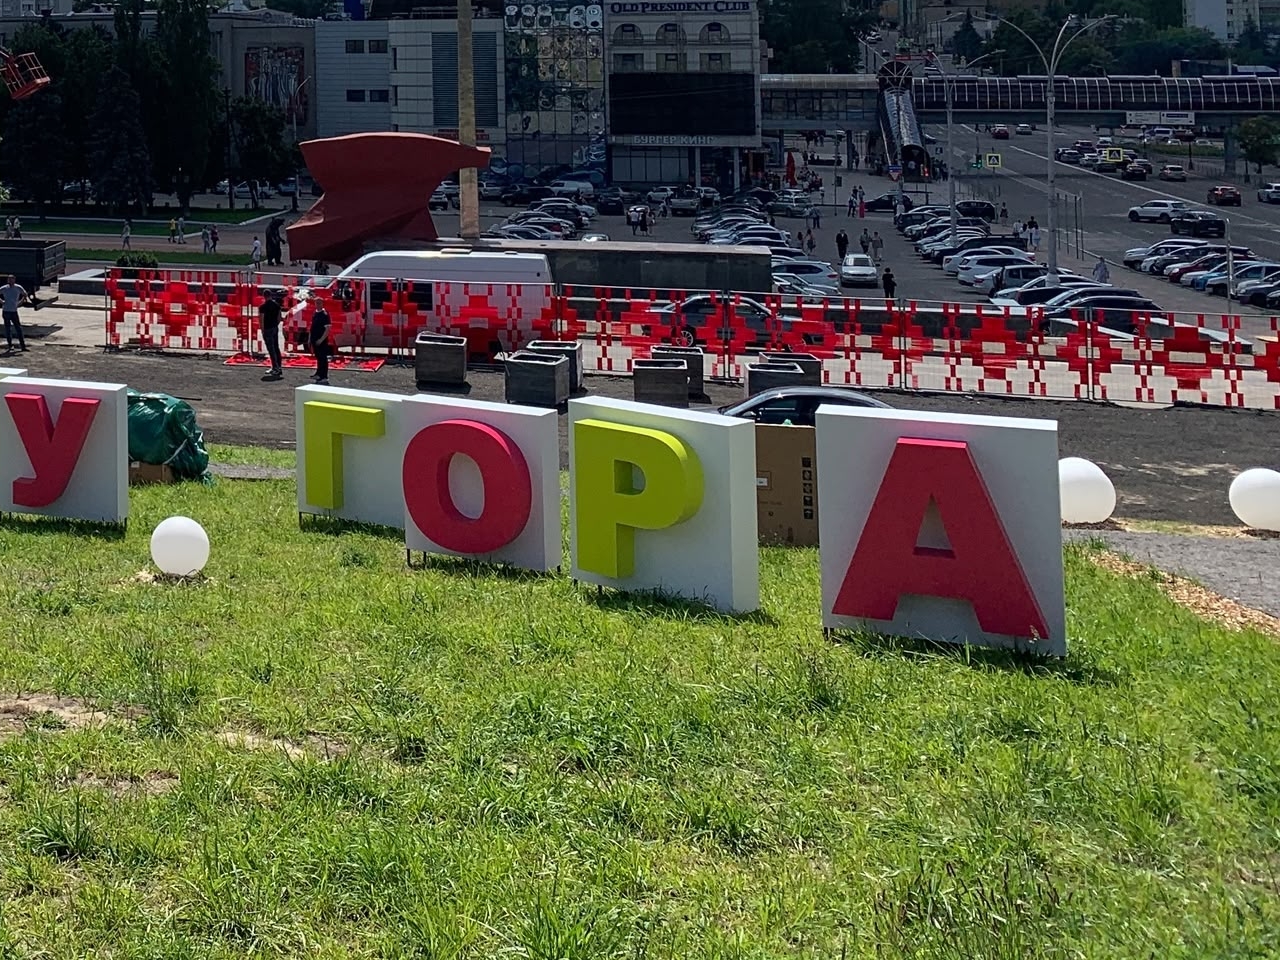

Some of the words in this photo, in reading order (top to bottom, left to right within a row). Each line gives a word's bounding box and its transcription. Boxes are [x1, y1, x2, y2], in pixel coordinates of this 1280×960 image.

[610, 1, 639, 14] OLD
[641, 1, 711, 13] PRESIDENT
[713, 0, 750, 12] CLUB
[633, 135, 677, 144] БУРГЕР
[679, 135, 714, 145] КИНГ
